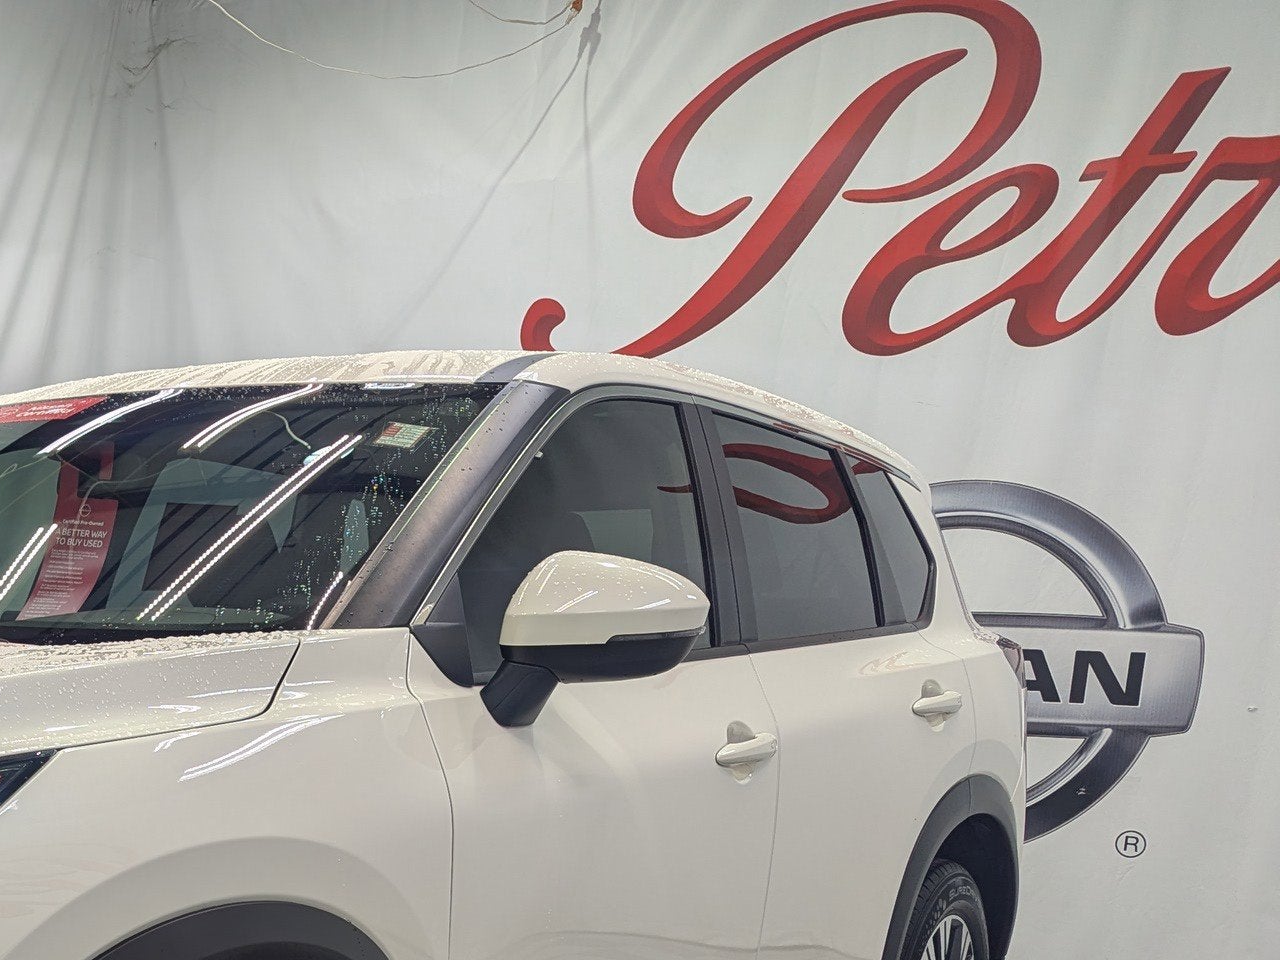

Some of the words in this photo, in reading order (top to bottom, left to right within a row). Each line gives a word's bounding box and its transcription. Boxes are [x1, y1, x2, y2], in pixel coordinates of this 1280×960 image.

[520, 0, 1280, 356] Petr
[61, 527, 91, 538] BETTER
[91, 530, 108, 538] WAY
[56, 536, 66, 545] TO
[66, 537, 82, 546] BUY
[83, 539, 103, 548] USED
